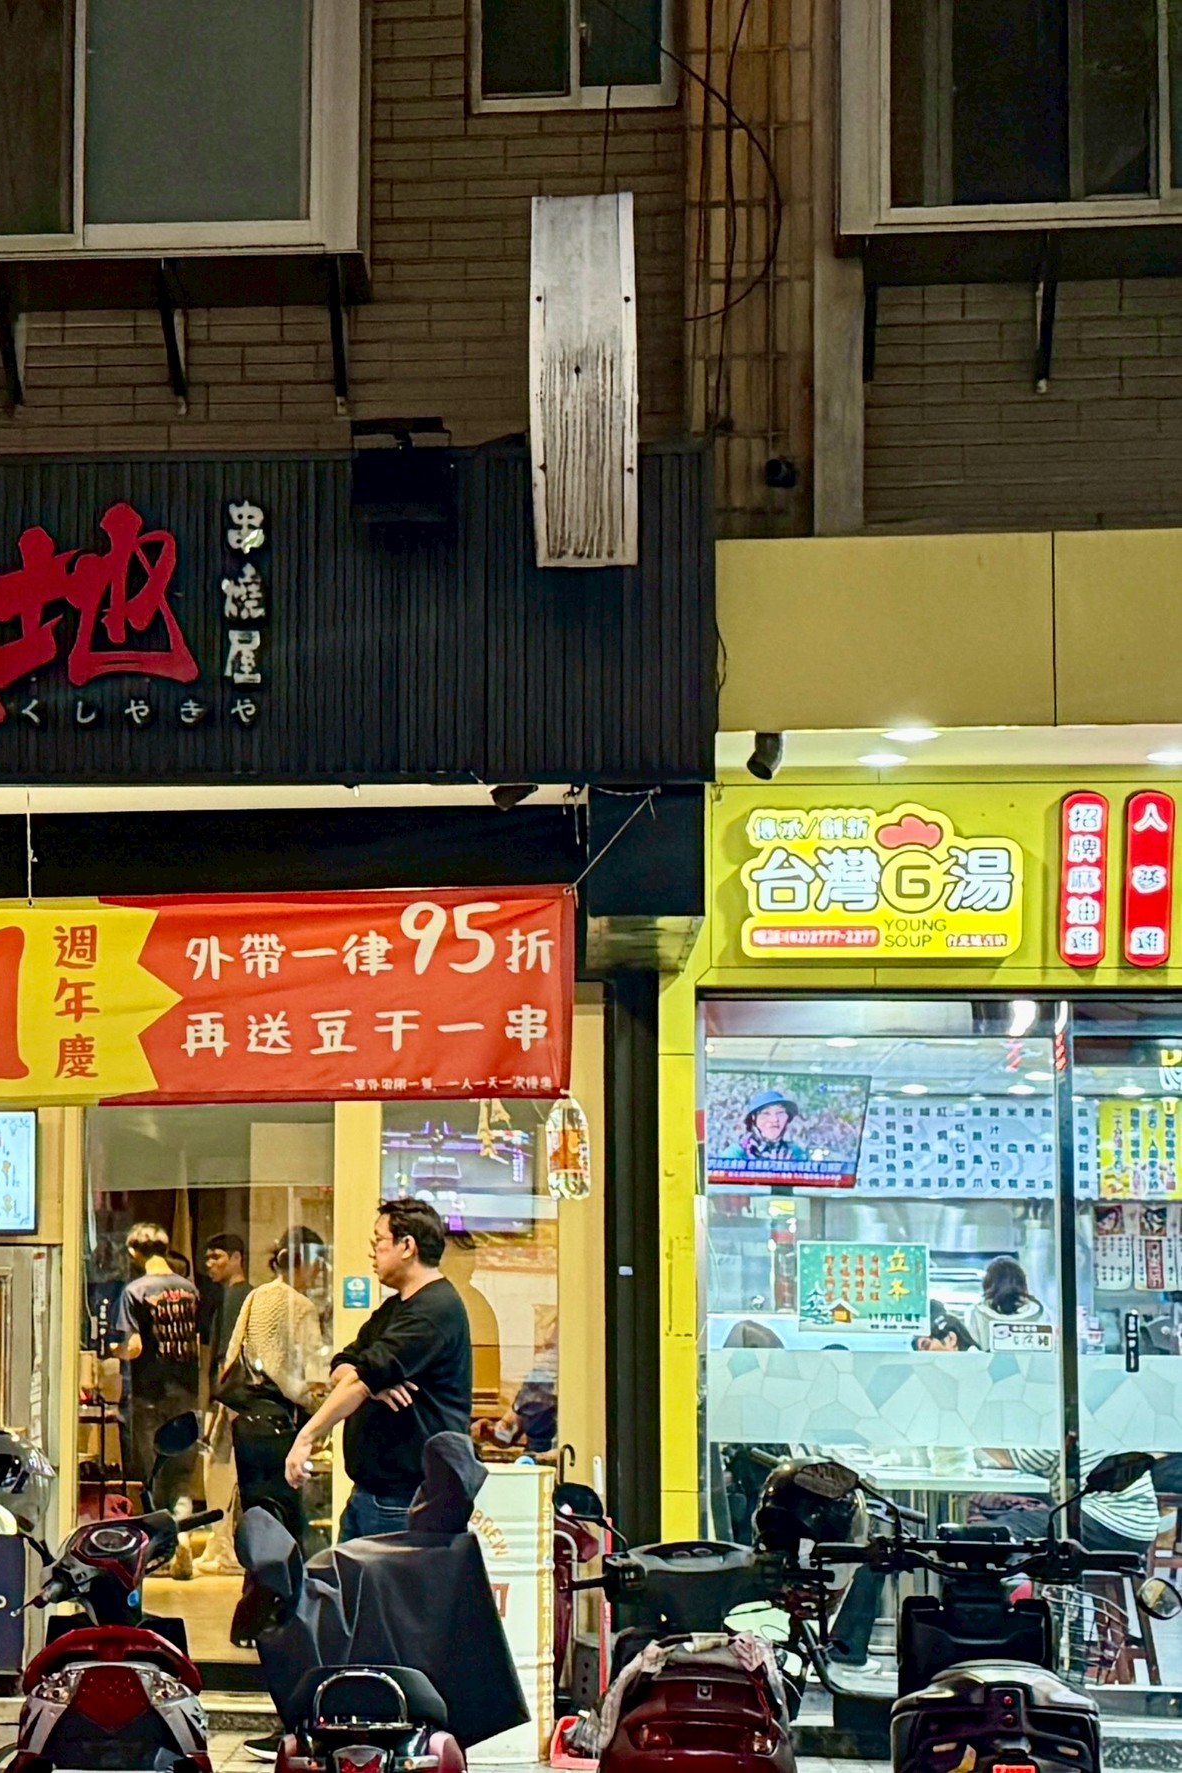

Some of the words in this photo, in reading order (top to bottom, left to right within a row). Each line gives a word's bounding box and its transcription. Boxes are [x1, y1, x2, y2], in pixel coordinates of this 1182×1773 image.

[21, 699, 257, 726] くしやきや
[750, 847, 1015, 913] 台灣G湯
[184, 900, 555, 982] 外帶一律95折
[884, 918, 947, 932] YOUNG
[884, 934, 932, 948] SOUP
[52, 924, 100, 1079] 週年慶
[182, 1003, 550, 1057] 再送豆干一串
